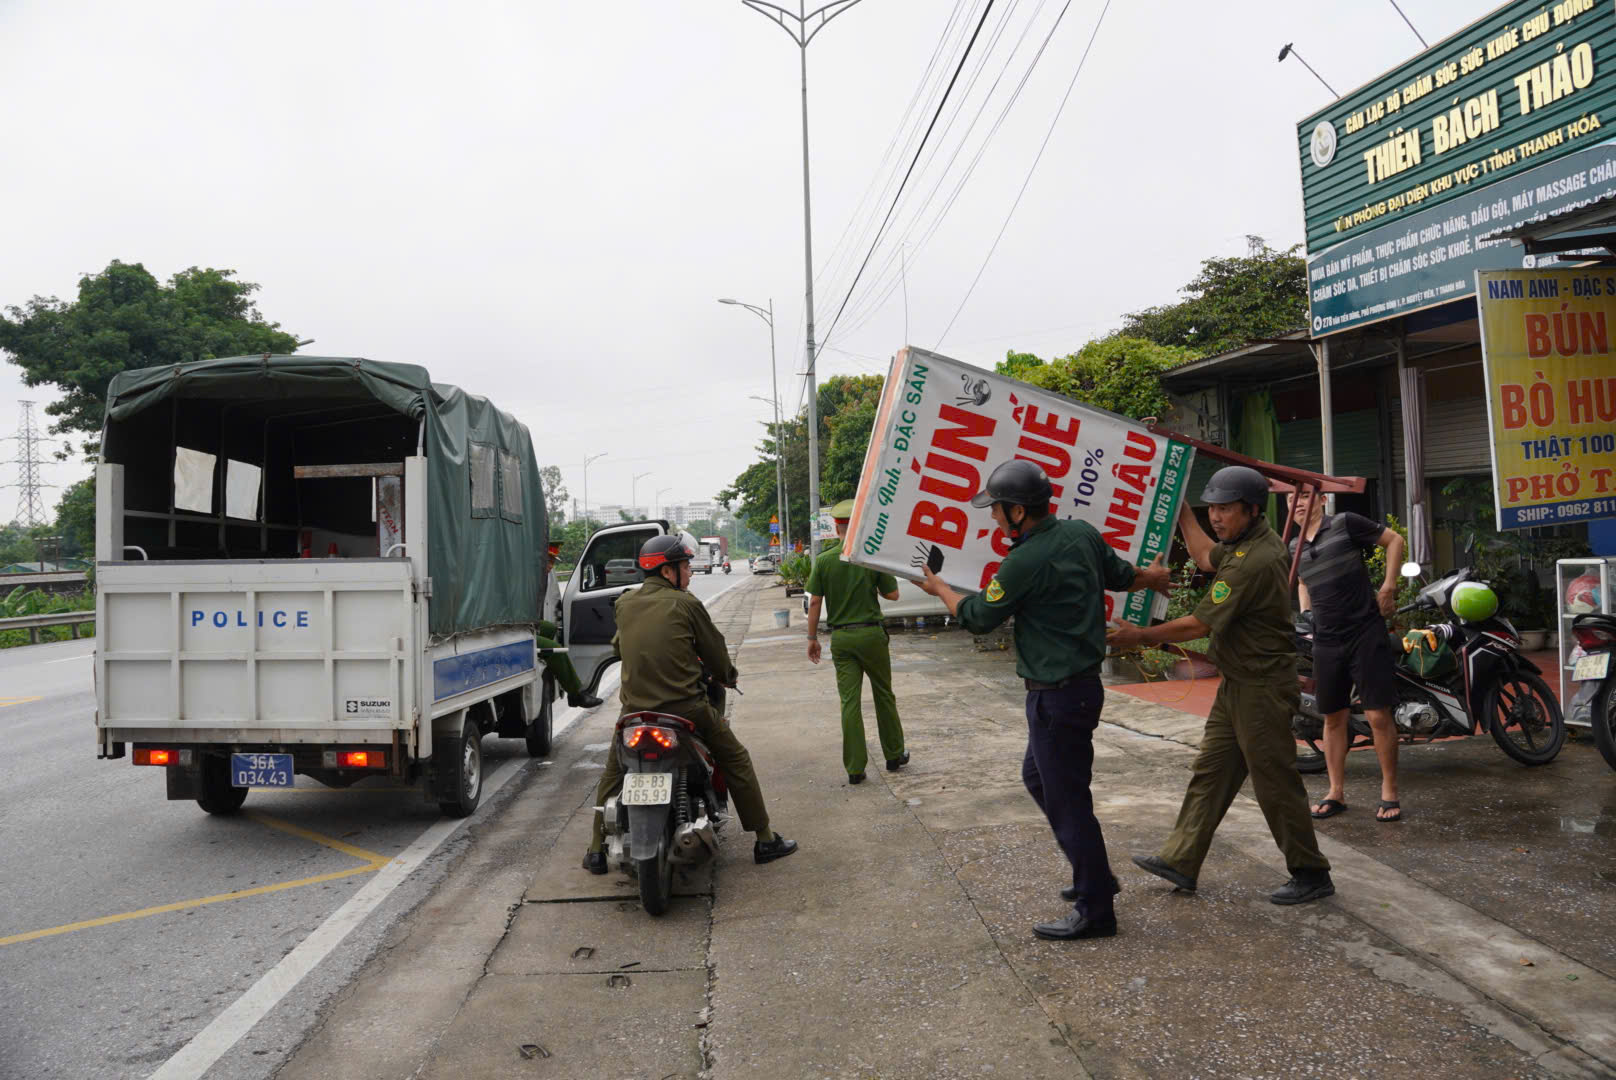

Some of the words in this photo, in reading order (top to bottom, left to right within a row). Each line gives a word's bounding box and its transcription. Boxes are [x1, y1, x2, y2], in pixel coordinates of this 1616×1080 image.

[1345, 112, 1364, 134] CÂU
[1366, 101, 1384, 124] LẠC
[1386, 88, 1400, 113] BỘ
[1402, 75, 1433, 105] CHĂM
[1435, 60, 1458, 88] SÓC
[1460, 46, 1484, 75] SỨC
[1487, 25, 1519, 61] KHỎE
[1522, 6, 1550, 41] CHỦ
[1363, 126, 1422, 185] THIÊN
[1432, 88, 1500, 155] BÁCH
[1514, 42, 1594, 115] THẢO
[1353, 202, 1387, 226] PHÒNG
[1388, 195, 1407, 213] ĐẠI
[1406, 183, 1429, 204] DIỆN
[1431, 172, 1453, 195] KHU
[1454, 163, 1479, 185] VỰC
[1482, 160, 1488, 173] 1
[1488, 148, 1517, 170] TỈNH
[1519, 128, 1563, 158] THANH
[1567, 112, 1601, 139] HÓA
[1311, 266, 1326, 282] MUA
[1326, 260, 1340, 277] BÁN
[1340, 254, 1351, 272] MỸ
[1375, 240, 1394, 259] THỰC
[1395, 229, 1419, 252] PHẨM
[1420, 223, 1442, 244] CHỨC
[1443, 215, 1470, 236] NĂNG,
[1491, 198, 1511, 220] GỘI,
[1512, 189, 1534, 212] MÁY
[1536, 171, 1587, 203] MASSAGE
[1312, 285, 1333, 302] CHĂM
[1333, 279, 1347, 297] SÓC
[1347, 277, 1359, 292] DA,
[1359, 266, 1378, 287] THIẾT
[1379, 266, 1388, 283] BỊ
[1388, 258, 1411, 278] CHĂM
[1412, 252, 1429, 270] SÓC
[1430, 246, 1447, 265] SỨC
[1487, 279, 1524, 299] NAM
[1528, 278, 1559, 299] ANH
[1572, 274, 1601, 300] ĐẶC
[1322, 316, 1333, 328] 278
[1524, 302, 1609, 359] BÚN
[1500, 371, 1555, 430] BÒ
[863, 512, 889, 556] Nam
[877, 467, 902, 507] Anh
[893, 410, 917, 451] ĐẶC
[905, 364, 929, 405] SẢN
[1009, 392, 1081, 514] UẾ
[1168, 444, 1185, 468] 223
[1521, 434, 1572, 462] THẬT
[906, 403, 998, 550] BÚN
[1073, 448, 1104, 507] 100%
[1101, 430, 1158, 552] NHẬU
[1163, 466, 1178, 492] 765
[1506, 461, 1581, 503] PHỞ
[1590, 468, 1616, 493] T
[1153, 493, 1171, 523] 0975
[1517, 504, 1554, 522] SHIP:
[1557, 502, 1590, 518] 0962
[1146, 532, 1162, 554] 182
[1130, 587, 1148, 611] 096
[191, 610, 309, 628] POLICE
[1425, 681, 1451, 694] HONDA
[249, 755, 276, 771] 36A
[238, 771, 287, 785] 034.43
[630, 775, 665, 789] 36-B3
[627, 789, 668, 803] 165.93
